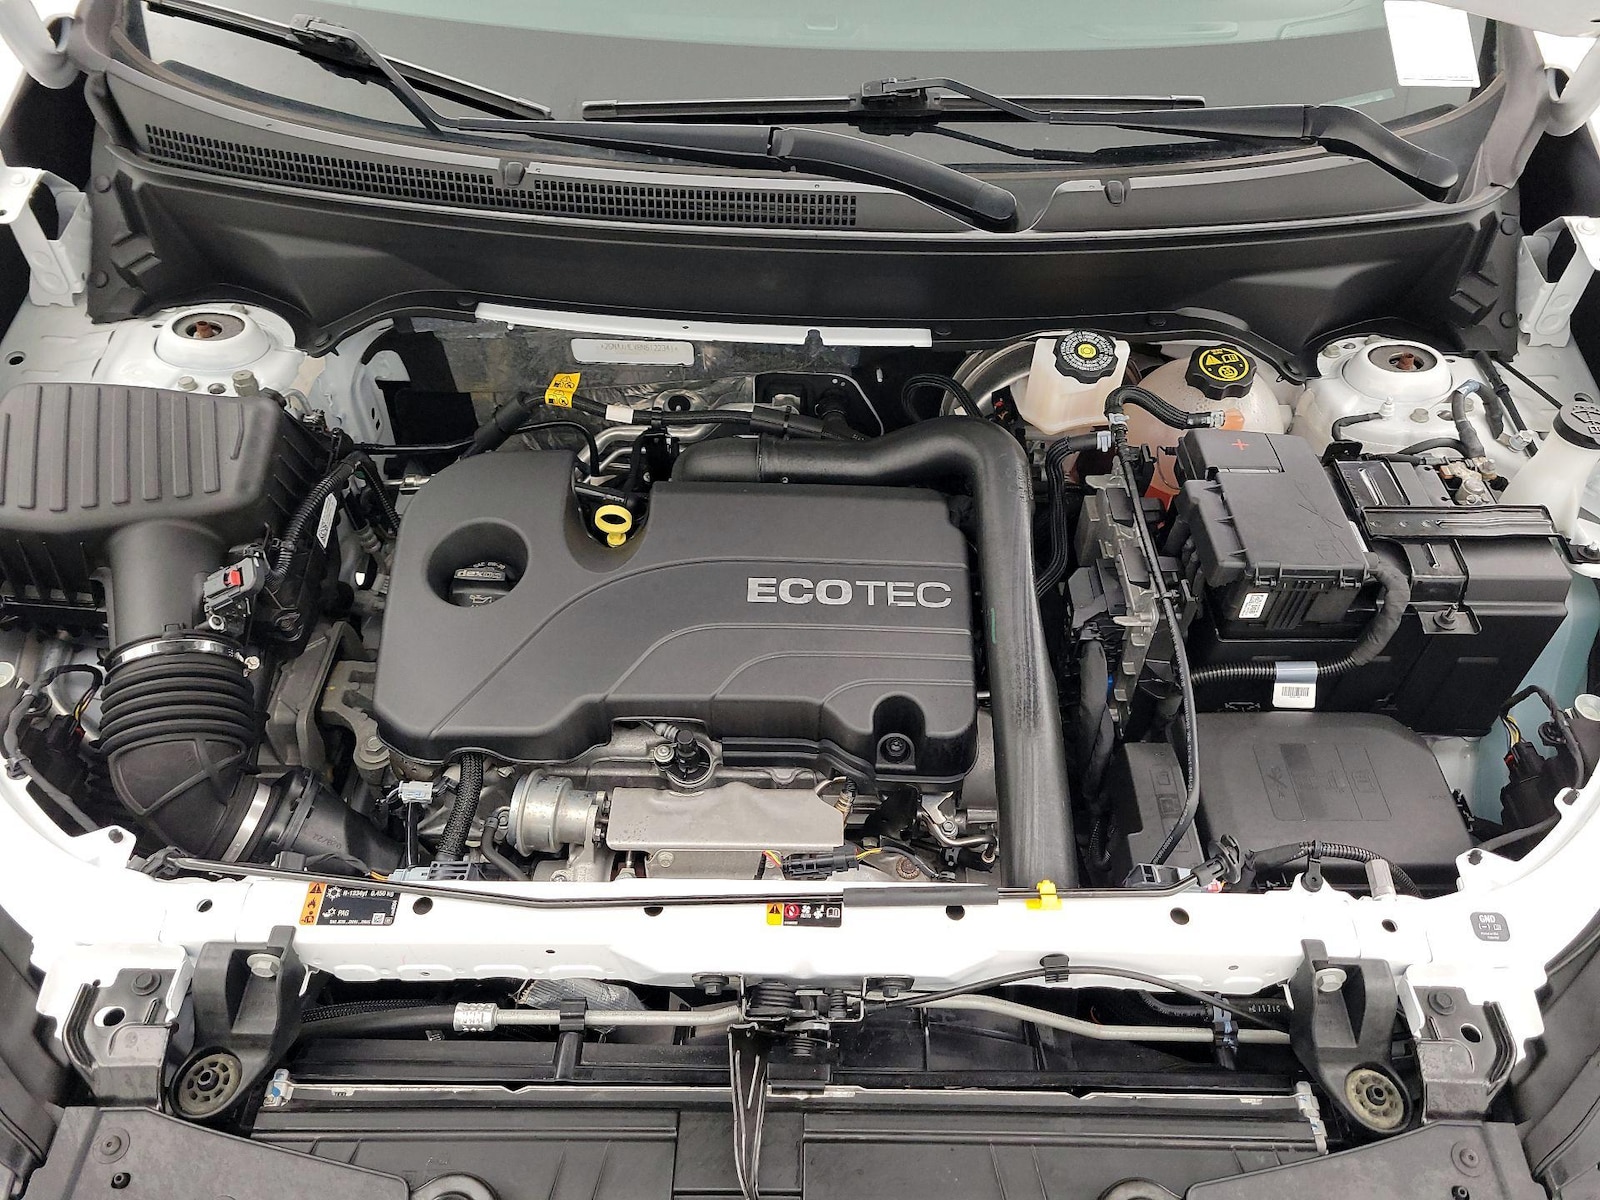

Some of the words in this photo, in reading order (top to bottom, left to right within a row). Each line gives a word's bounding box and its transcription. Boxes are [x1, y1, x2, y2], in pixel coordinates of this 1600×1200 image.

[457, 569, 502, 579] dexos
[746, 577, 952, 608] ECOTEC
[337, 909, 350, 917] PAG
[1478, 914, 1496, 923] GND
